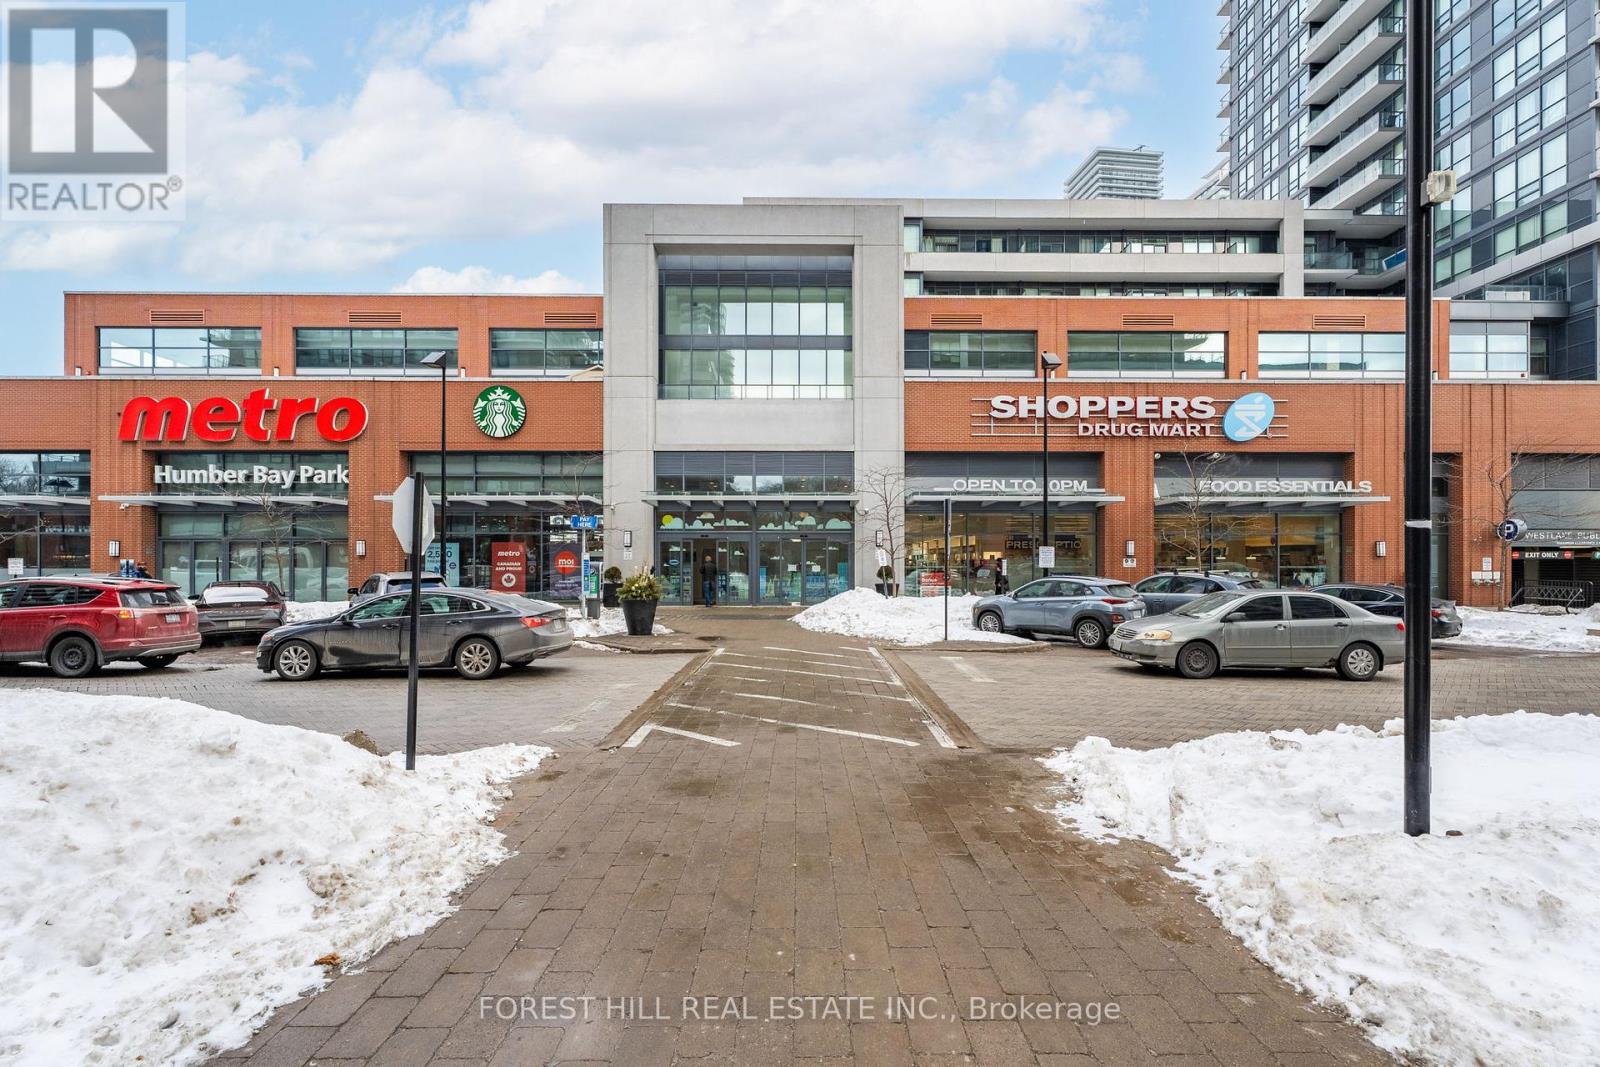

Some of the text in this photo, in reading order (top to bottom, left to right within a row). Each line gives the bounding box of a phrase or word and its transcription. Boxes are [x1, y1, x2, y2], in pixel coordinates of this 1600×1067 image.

[989, 395, 1216, 419] SHOPPERS
[118, 388, 369, 442] metro
[1077, 422, 1214, 437] DRUG MART
[154, 464, 349, 489] Humber Bay Park
[953, 479, 1088, 492] OPEN TO 0PM
[1200, 480, 1373, 493] FOOD ESSENTIALS
[1504, 524, 1514, 538] P
[1006, 540, 1082, 549] PRESPTIO
[427, 550, 453, 559] 2,50
